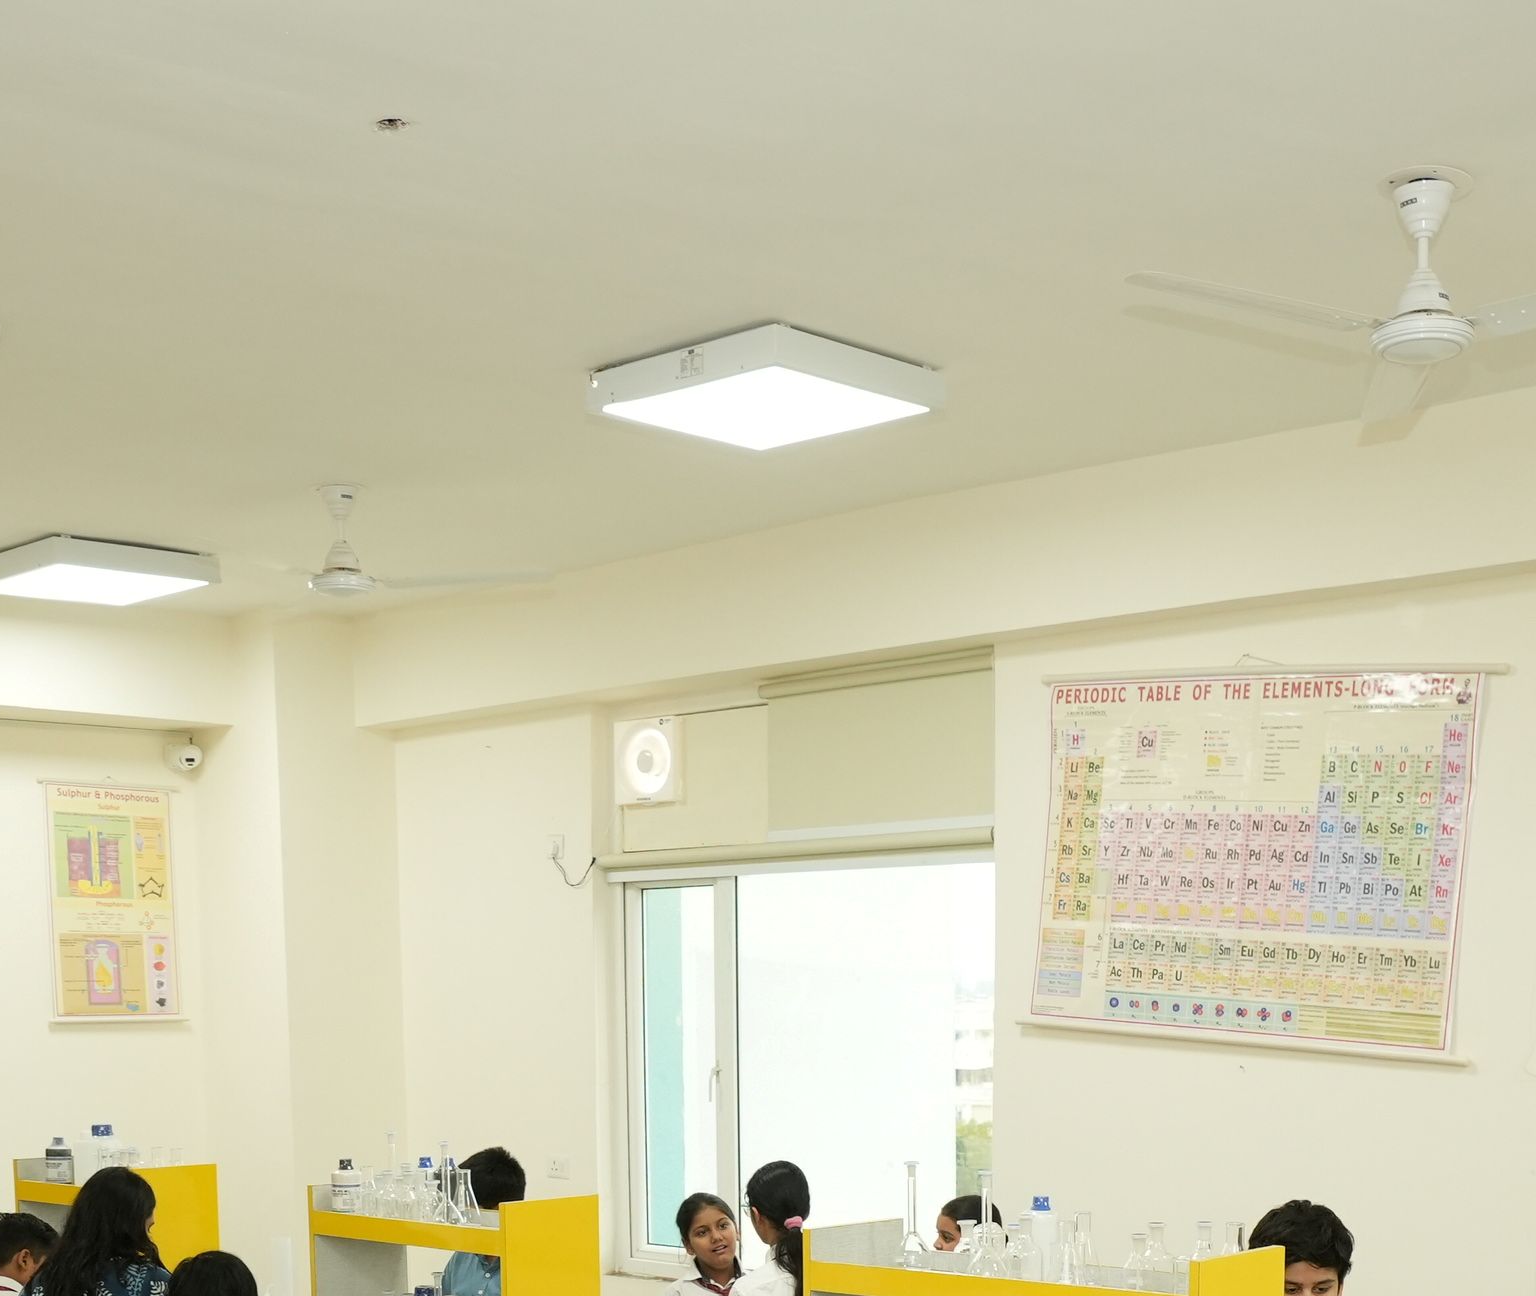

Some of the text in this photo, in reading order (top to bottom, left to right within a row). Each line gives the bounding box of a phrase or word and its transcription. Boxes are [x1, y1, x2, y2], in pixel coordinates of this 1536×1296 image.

[1056, 687, 1127, 704] PERIODIC
[1138, 685, 1181, 702] TABLE
[1193, 684, 1211, 700] OF
[1224, 683, 1251, 700] THE
[1073, 735, 1079, 744] H
[1449, 730, 1462, 741] He
[1088, 762, 1100, 772] Be
[1329, 761, 1336, 773] B
[1351, 761, 1358, 773] C
[1374, 761, 1382, 773] N
[1425, 761, 1432, 773] F
[1448, 761, 1461, 773] Ne
[57, 788, 159, 803] Sulphur & Phosphorous
[1067, 790, 1078, 801] Na
[1087, 790, 1098, 803] Mg
[1348, 792, 1357, 803] Si
[1372, 792, 1379, 803] P
[1396, 792, 1403, 803] S
[1445, 793, 1457, 804] Ar
[1067, 818, 1072, 828] K
[1084, 818, 1094, 828] Ca
[1126, 818, 1133, 829] Ti
[1146, 819, 1152, 829] V
[1164, 819, 1175, 830] Cr
[1185, 819, 1197, 830] Mn
[1208, 819, 1219, 830] Fe
[1230, 820, 1241, 831] Co
[1252, 820, 1263, 831] Ni
[1274, 820, 1287, 832] Cu
[1299, 821, 1310, 832] Zn
[1321, 822, 1334, 833] Ga
[1344, 822, 1356, 834] Ge
[1366, 823, 1379, 834] As
[1390, 823, 1404, 834] Se
[1415, 823, 1428, 834] Br
[1442, 824, 1454, 836] Kr
[1271, 850, 1284, 863] Ag
[1294, 851, 1308, 862] Cd
[1320, 852, 1329, 863] In
[1364, 853, 1377, 864] Sb
